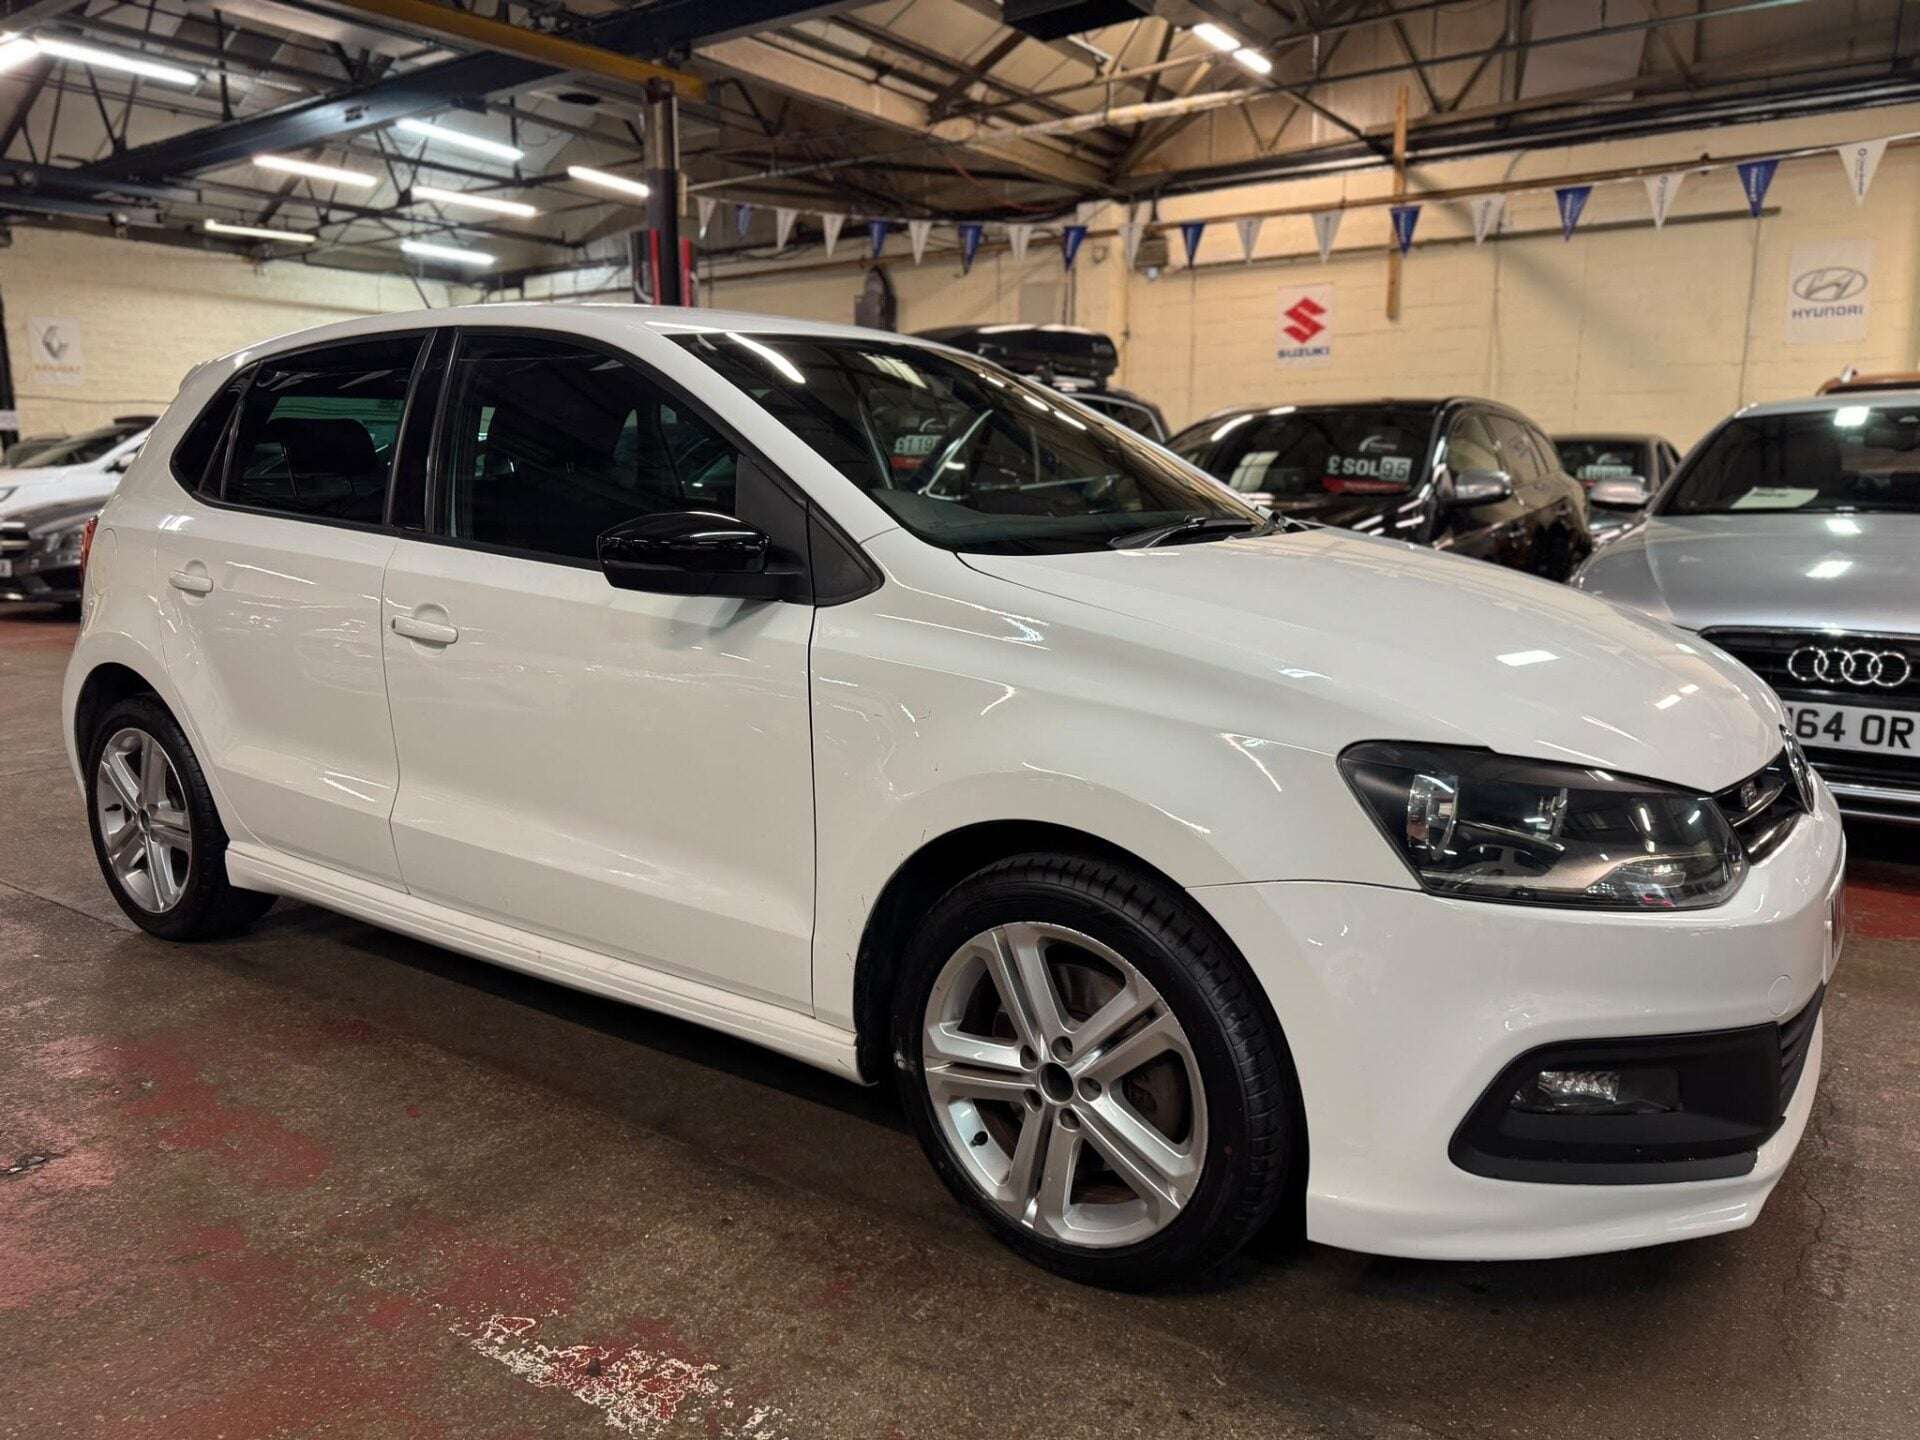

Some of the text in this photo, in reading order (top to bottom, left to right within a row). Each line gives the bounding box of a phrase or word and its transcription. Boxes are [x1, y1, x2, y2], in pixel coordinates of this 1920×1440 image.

[1792, 304, 1863, 319] HYUNDAI
[1277, 346, 1330, 359] SUZUKI
[1787, 707, 1914, 749] 64 OR
